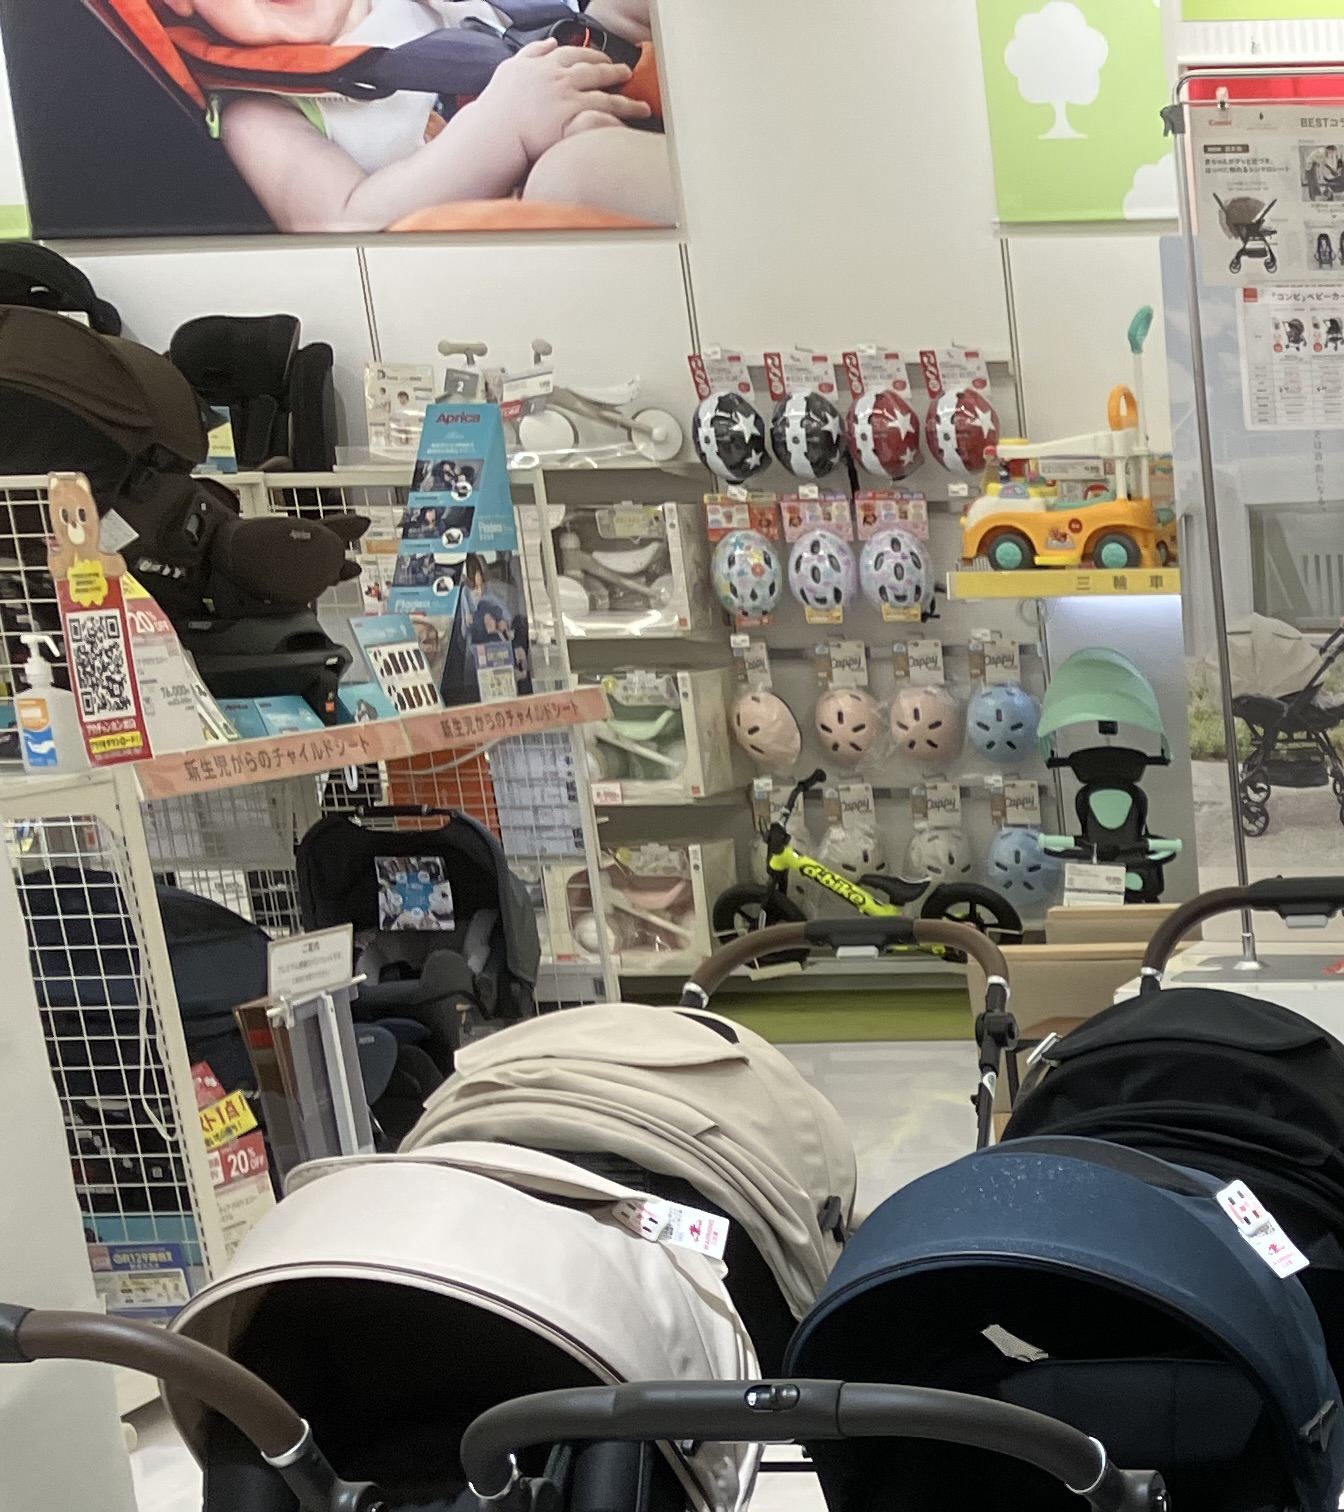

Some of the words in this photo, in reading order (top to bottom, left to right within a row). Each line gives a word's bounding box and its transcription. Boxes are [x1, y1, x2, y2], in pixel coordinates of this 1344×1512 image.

[436, 411, 481, 425] Aprica
[184, 734, 371, 782] 新生児からのチャイルドシート
